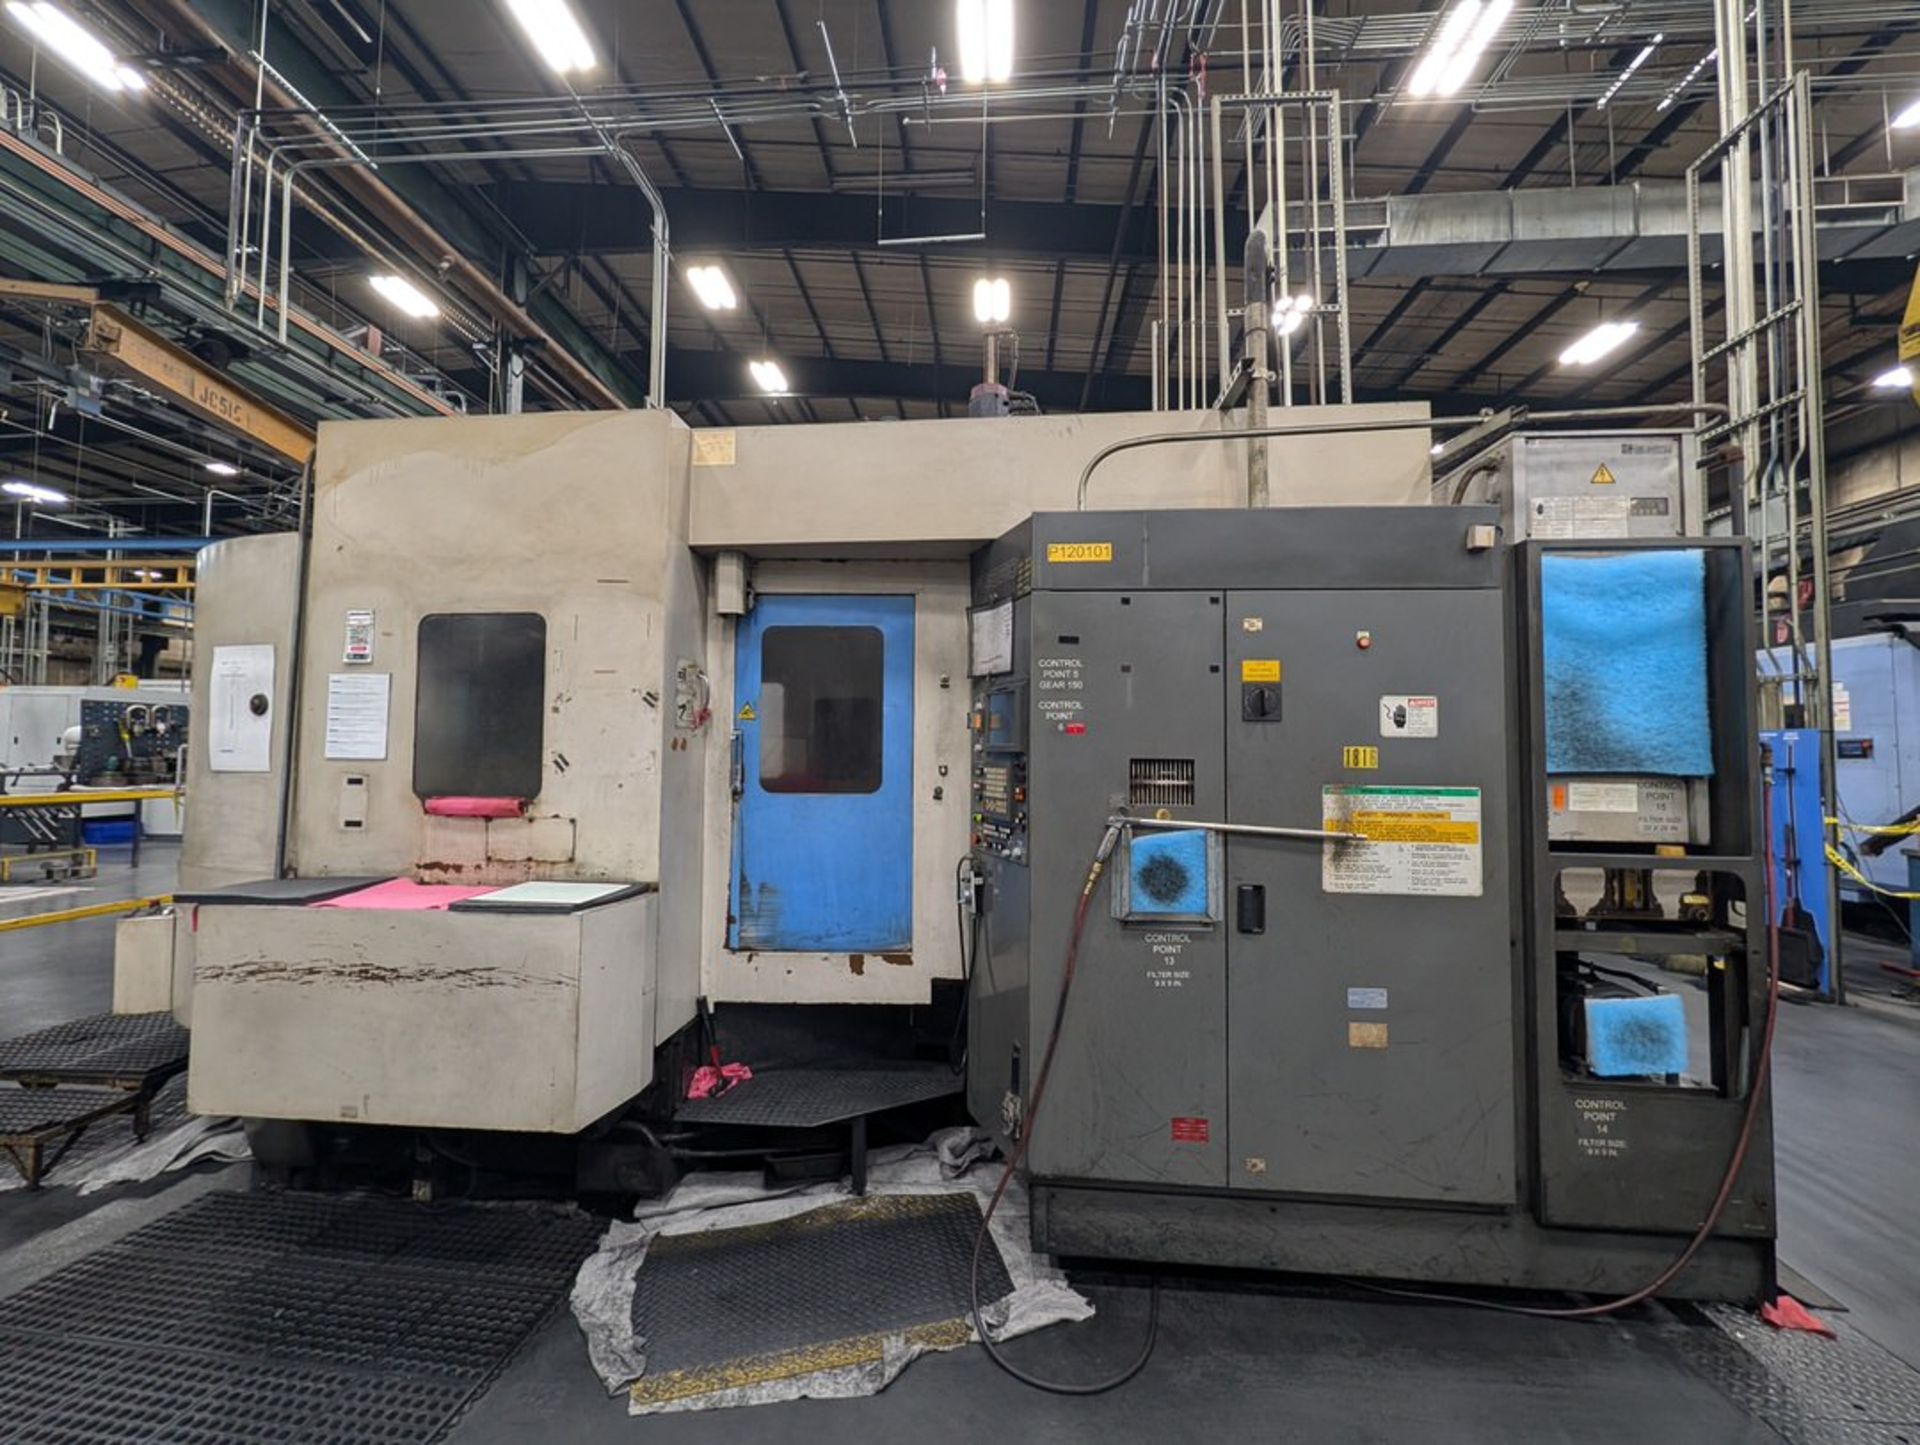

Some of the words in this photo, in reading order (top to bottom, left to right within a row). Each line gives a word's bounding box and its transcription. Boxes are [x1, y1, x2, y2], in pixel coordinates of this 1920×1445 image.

[1048, 544, 1110, 559] P120101
[1038, 659, 1083, 668] CONTROL
[1043, 669, 1071, 679] POINT
[1039, 680, 1066, 690] GEAR
[1038, 700, 1083, 710] CONTROL
[1045, 711, 1073, 721] POINT
[1646, 792, 1675, 801] POINT
[1144, 933, 1191, 943] CONTROL
[1153, 945, 1182, 954] POINT
[1164, 956, 1175, 966] 13
[1574, 1099, 1627, 1110] CONTROL
[1583, 1111, 1616, 1121] POINT
[1596, 1124, 1608, 1134] 14
